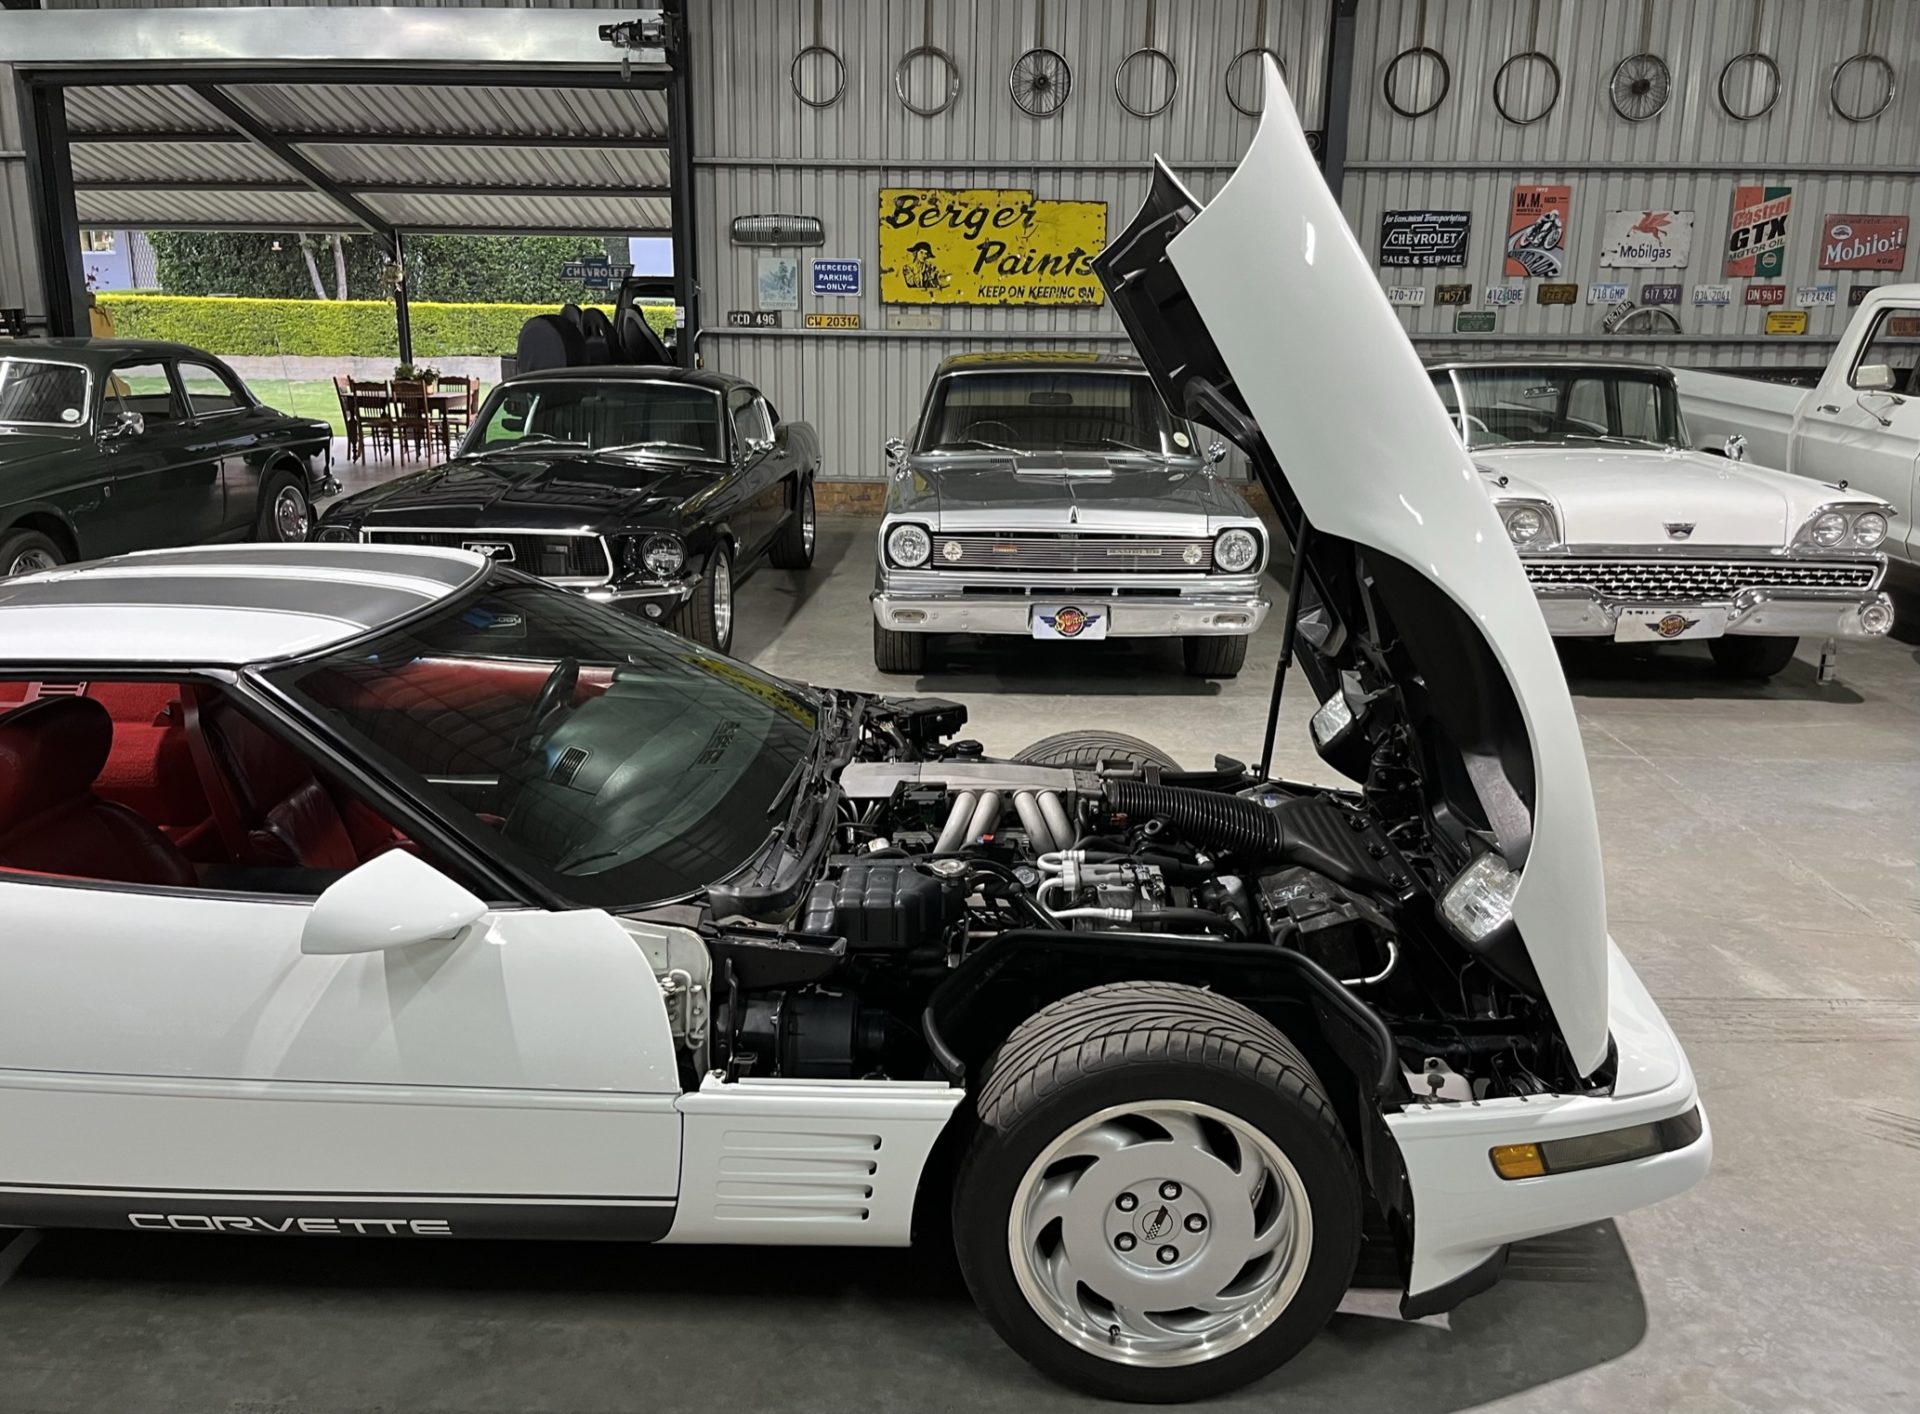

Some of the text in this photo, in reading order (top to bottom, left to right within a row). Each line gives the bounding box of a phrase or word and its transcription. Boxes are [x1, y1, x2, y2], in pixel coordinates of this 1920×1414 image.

[886, 194, 1036, 240] Berger
[1732, 195, 1792, 230] Castrol
[1391, 233, 1457, 244] CHEVROLET
[1730, 214, 1788, 252] GTX
[1728, 243, 1766, 262] MOTOR
[1768, 239, 1786, 248] OIL
[1823, 227, 1903, 266] Mobiloil
[973, 241, 1095, 276] Paints
[1382, 254, 1462, 264] SALES & SERVICE
[1620, 245, 1672, 262] Mobilgas
[566, 268, 627, 278] CHEVROLET
[814, 264, 858, 272] MERCEDES
[818, 274, 854, 282] PARKING
[826, 283, 847, 291] ONLY
[978, 285, 1006, 298] KEEP
[1008, 285, 1025, 298] ON
[1645, 288, 1677, 299] 617 921
[1762, 289, 1783, 300] 9615
[755, 313, 775, 325] 496
[807, 316, 859, 327] CW 20314
[128, 1212, 453, 1235] CORVETTE
